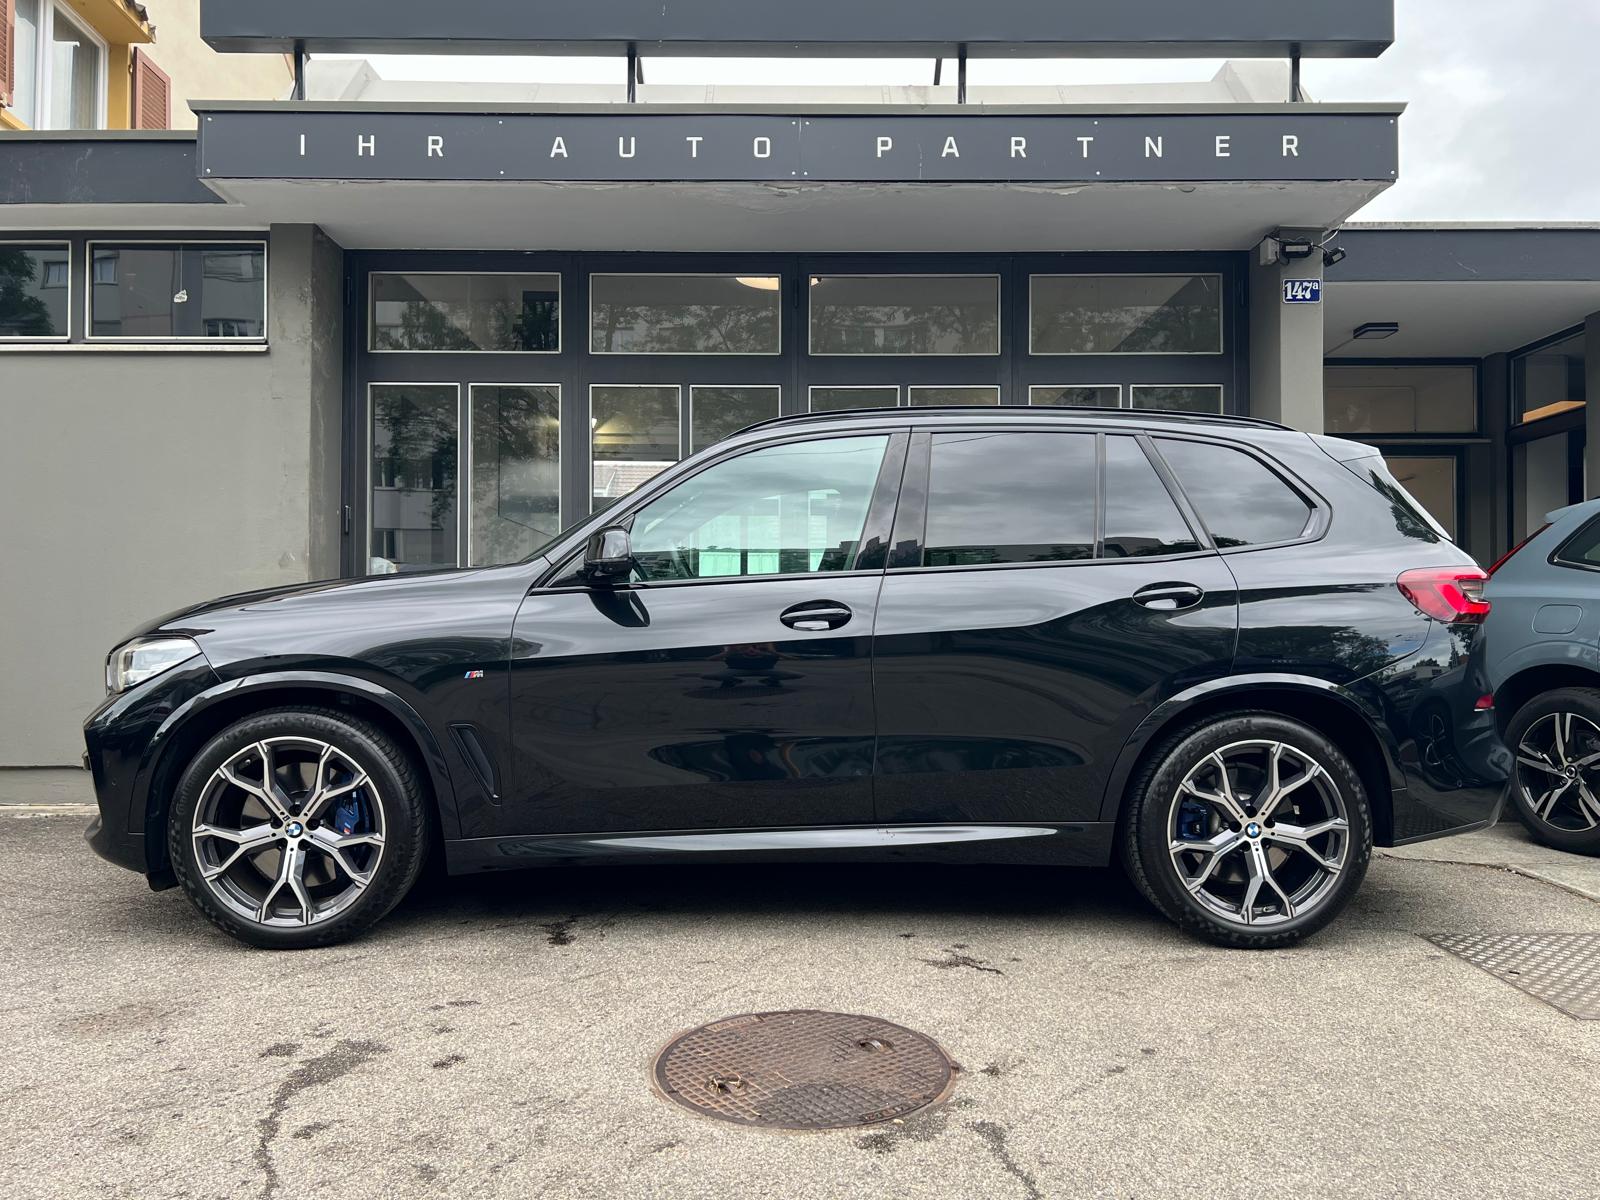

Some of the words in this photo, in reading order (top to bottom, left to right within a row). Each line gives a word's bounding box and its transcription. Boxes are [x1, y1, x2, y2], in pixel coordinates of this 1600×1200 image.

[299, 134, 445, 157] IHR
[549, 136, 772, 158] AUTO
[876, 134, 1301, 158] PARTNER
